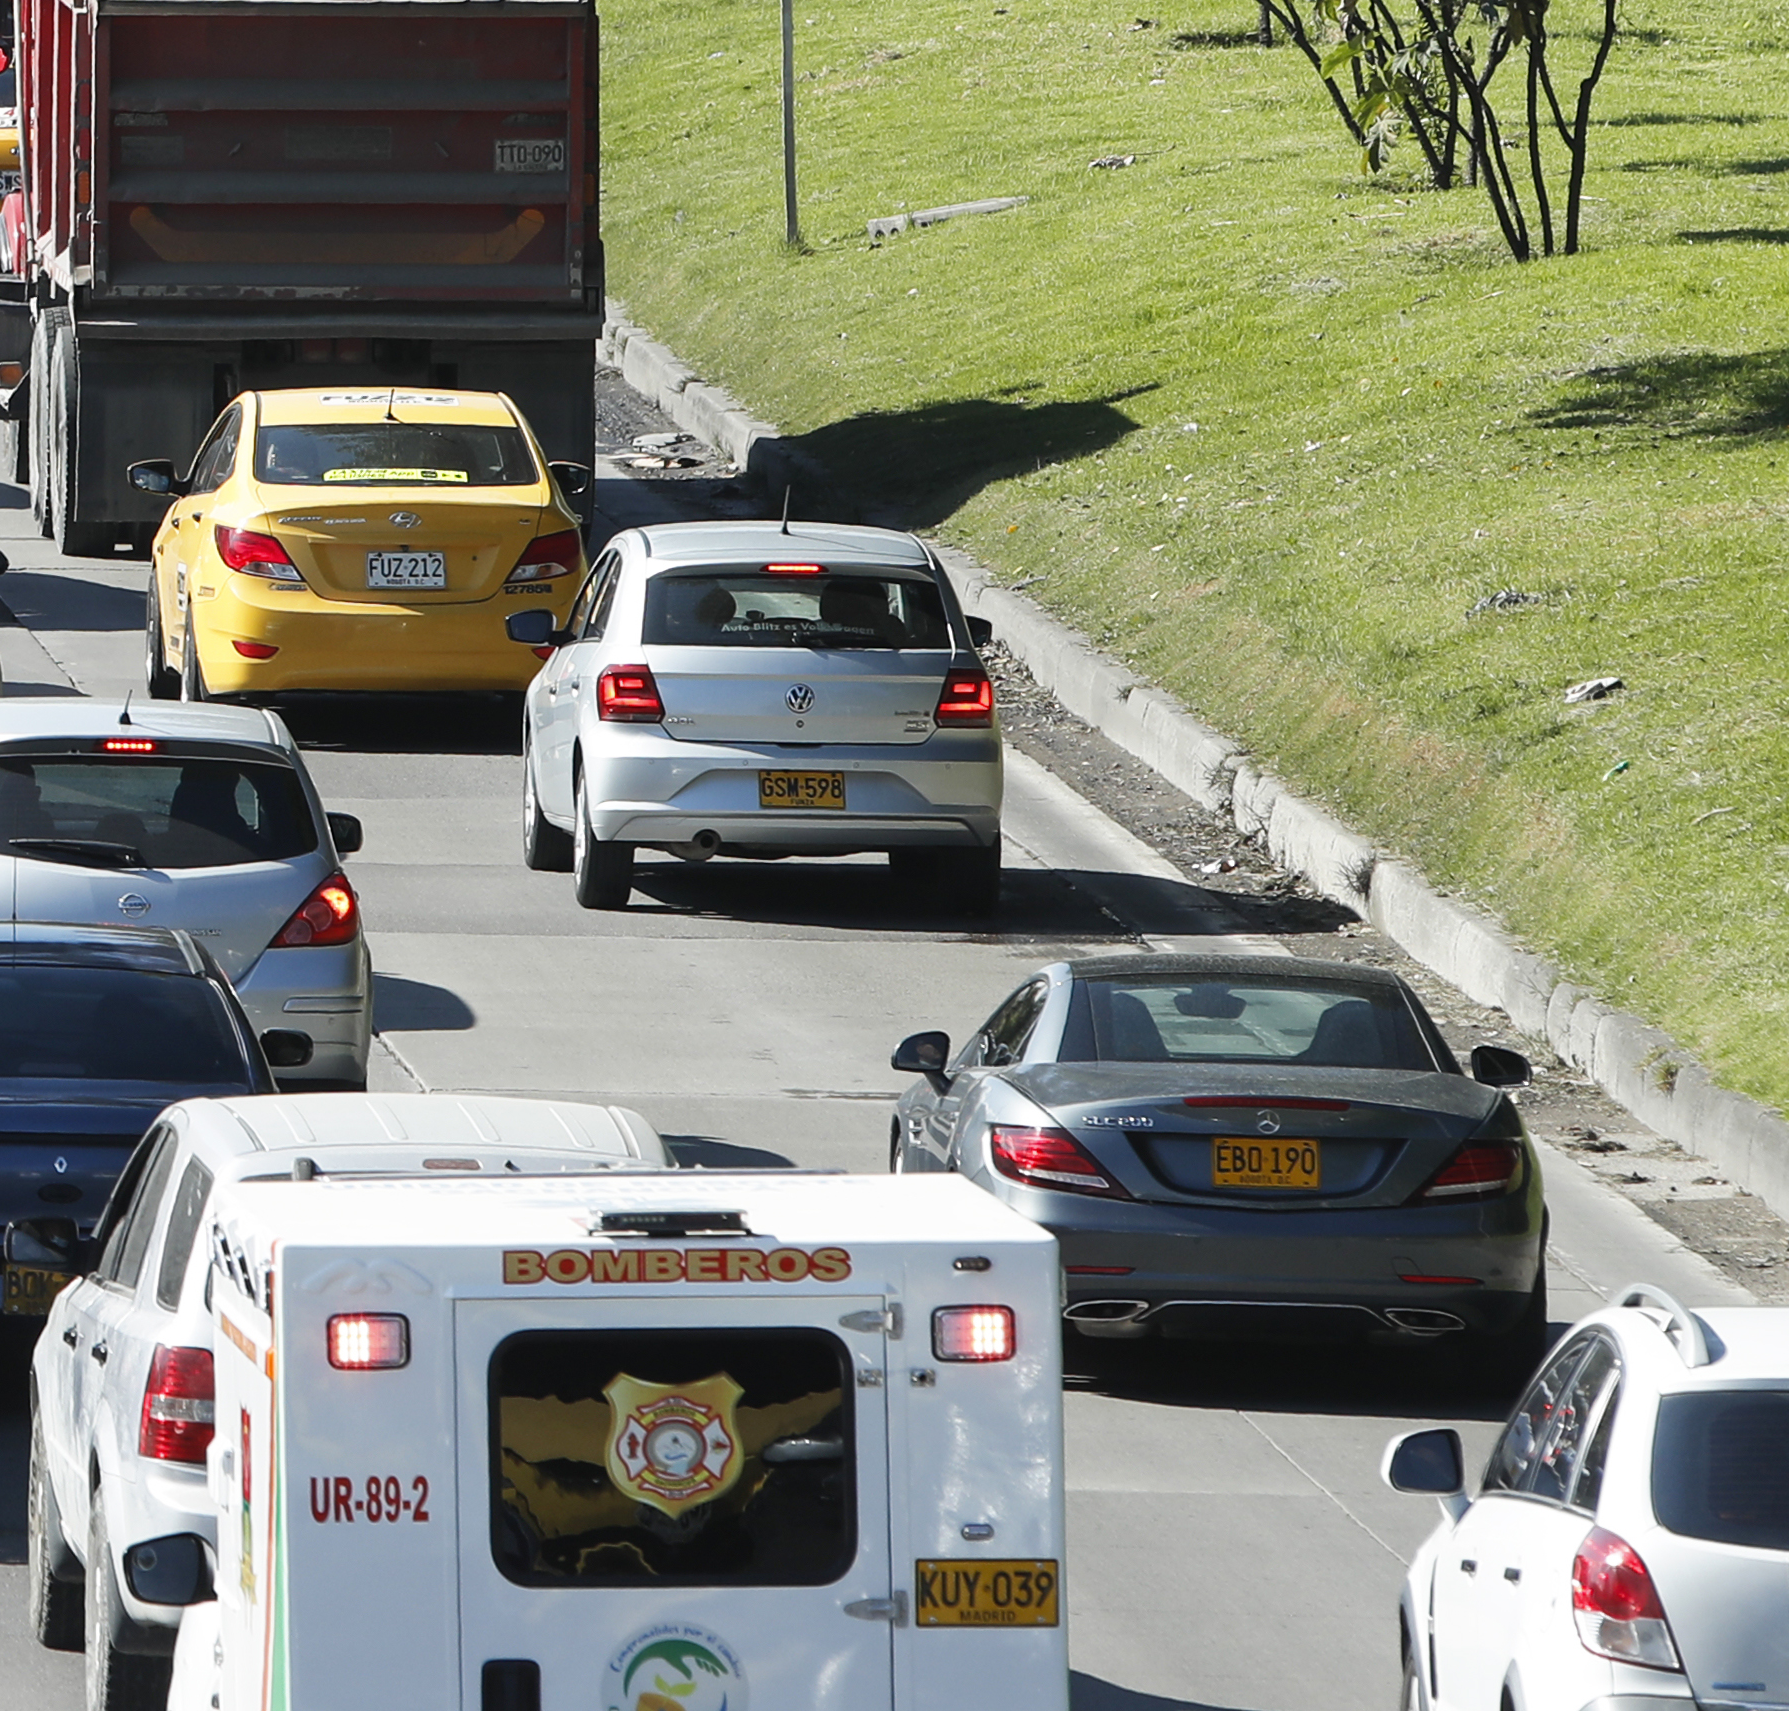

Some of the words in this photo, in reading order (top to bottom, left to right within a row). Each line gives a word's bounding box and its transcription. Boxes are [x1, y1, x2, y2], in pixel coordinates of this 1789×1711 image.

[721, 623, 749, 632] Auto
[753, 622, 780, 631] Blitz
[503, 1247, 852, 1285] BOMBEROS
[310, 1476, 429, 1523] UR-89-2
[959, 1610, 1016, 1622] MADRID
